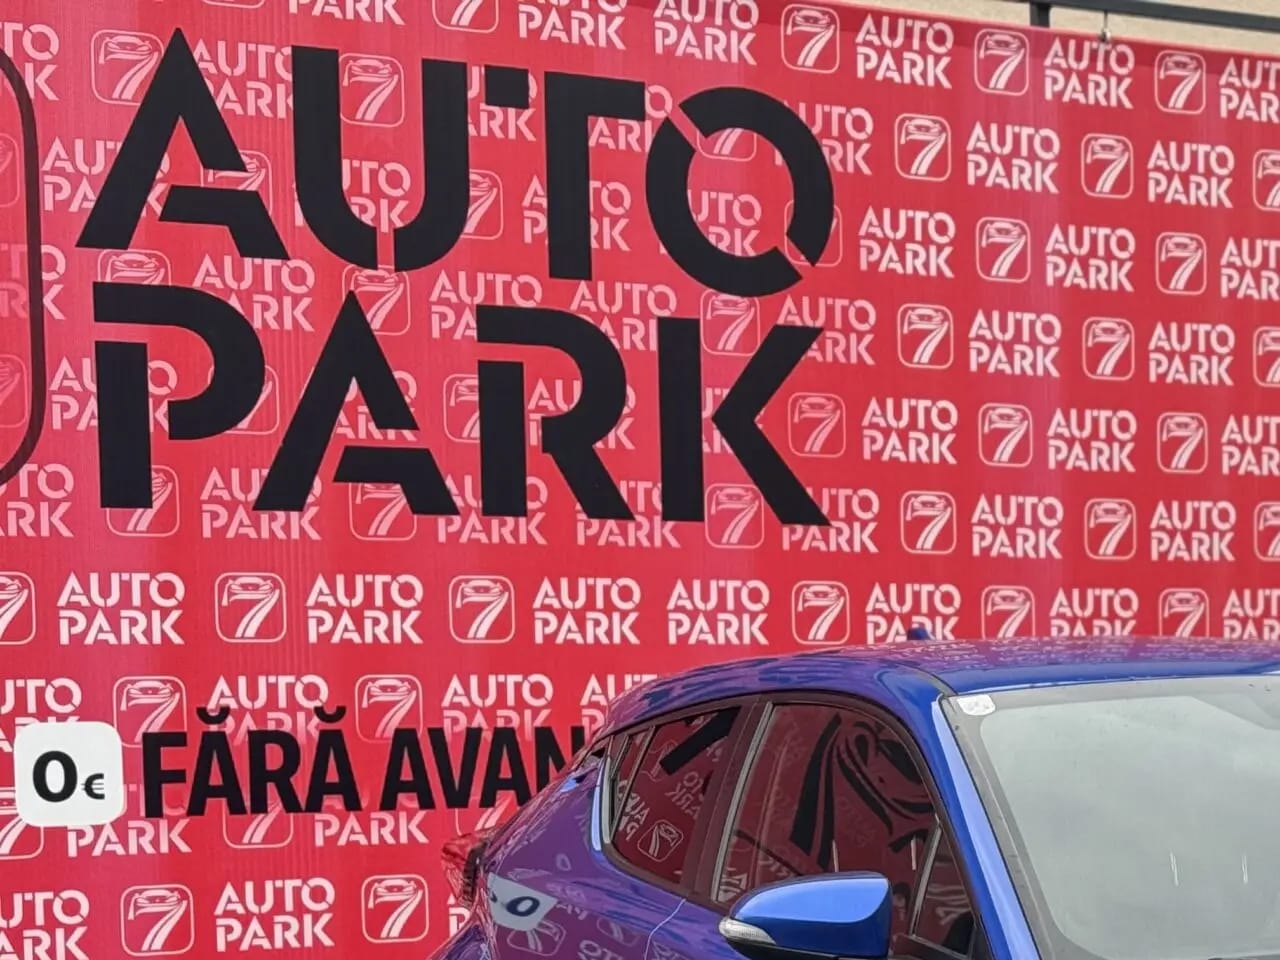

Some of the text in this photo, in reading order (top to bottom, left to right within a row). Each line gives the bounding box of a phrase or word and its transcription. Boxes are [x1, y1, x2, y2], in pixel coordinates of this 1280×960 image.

[519, 9, 627, 50] PARK
[653, 0, 759, 29] AUTO
[856, 13, 954, 53] AUTO
[0, 22, 59, 60] TO
[654, 22, 757, 66] PARK
[1044, 37, 1135, 75] AUTO
[856, 46, 952, 89] PARK
[1044, 69, 1133, 109] PARK
[799, 102, 874, 140] UTO
[967, 121, 1061, 160] AUTO
[1147, 141, 1235, 176] AUTO
[76, 27, 835, 297] AUTO
[967, 153, 1059, 194] PARK
[689, 189, 761, 225] UTO
[1148, 171, 1232, 208] PARK
[859, 207, 956, 244] AUTO
[1045, 224, 1135, 259] AUTO
[192, 253, 315, 294] AUTO
[860, 239, 953, 278] PARK
[1045, 255, 1133, 292] PARK
[430, 270, 542, 308] AUTO
[570, 280, 677, 318] AUTO
[776, 296, 877, 331] AUTO
[968, 310, 1062, 344] AUTO
[803, 331, 876, 366] ARK
[1148, 322, 1235, 354] AUTO
[970, 340, 1060, 378] PARK
[1149, 352, 1233, 385] PARK
[93, 281, 833, 527] PARK
[862, 398, 958, 432] AUTO
[1047, 408, 1137, 442] AUTO
[863, 429, 956, 464] PARK
[1048, 438, 1135, 472] PARK
[202, 503, 322, 541] PARK
[437, 512, 548, 545] PARK
[576, 511, 681, 548] PARK
[972, 495, 1064, 528] AUTO
[1150, 500, 1236, 531] AUTO
[782, 521, 880, 553] PARK
[972, 525, 1061, 559] PARK
[1151, 529, 1234, 561] PARK
[57, 572, 185, 607] AUTO
[306, 574, 423, 608] AUTO
[533, 577, 641, 610] AUTO
[667, 579, 769, 613] AUTO
[865, 583, 961, 618] AUTO
[1049, 587, 1139, 619] AUTO
[59, 608, 184, 645] PARK
[308, 609, 422, 644] PARK
[535, 611, 640, 644] PARK
[668, 612, 768, 645] PARK
[0, 677, 82, 714] UTO
[207, 673, 329, 711] AUTO
[442, 673, 554, 706] AUTO
[142, 705, 363, 819] FĂRĂ
[67, 817, 193, 858] PARK
[314, 810, 429, 848] PARK
[0, 890, 89, 928] UTO
[215, 877, 335, 916] AUTO
[216, 913, 334, 951] PARK
